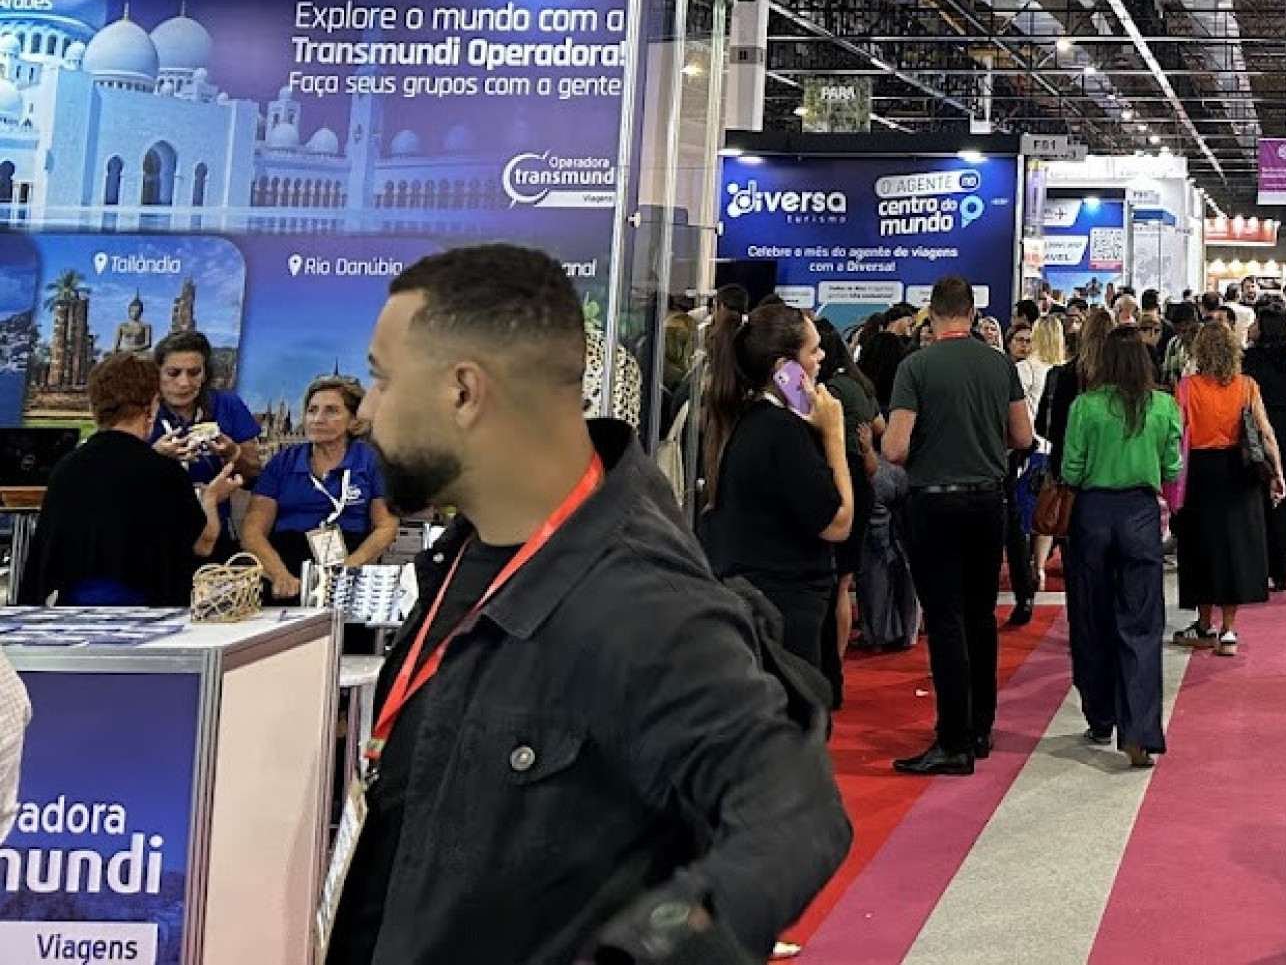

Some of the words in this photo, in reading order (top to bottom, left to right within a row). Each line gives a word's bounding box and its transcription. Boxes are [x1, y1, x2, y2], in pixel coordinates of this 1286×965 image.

[295, 0, 397, 33] Explore
[405, 8, 424, 30] o
[432, 2, 530, 31] mundo
[538, 7, 598, 31] com
[607, 9, 625, 32] a
[292, 37, 460, 65] Transmundi
[467, 37, 625, 70] Operadora!
[288, 71, 339, 97] Faça
[346, 75, 396, 94] seus
[403, 75, 478, 98] grupos
[484, 76, 530, 96] com
[537, 77, 550, 96] a
[548, 155, 610, 170] Operadora
[896, 175, 953, 193] AGENTE
[727, 180, 847, 217] diversa
[878, 196, 938, 216] centro
[940, 198, 958, 212] do
[880, 211, 954, 236] mundo
[747, 245, 791, 258] Celebre
[803, 245, 829, 258] mês
[832, 246, 846, 258] do
[848, 246, 891, 260] agente
[893, 246, 908, 258] de
[911, 245, 959, 260] viagens
[304, 257, 330, 276] Rio
[335, 256, 403, 276] Danúbio
[809, 262, 834, 272] com
[847, 261, 897, 273] Diversa!
[36, 933, 138, 965] Viagens
